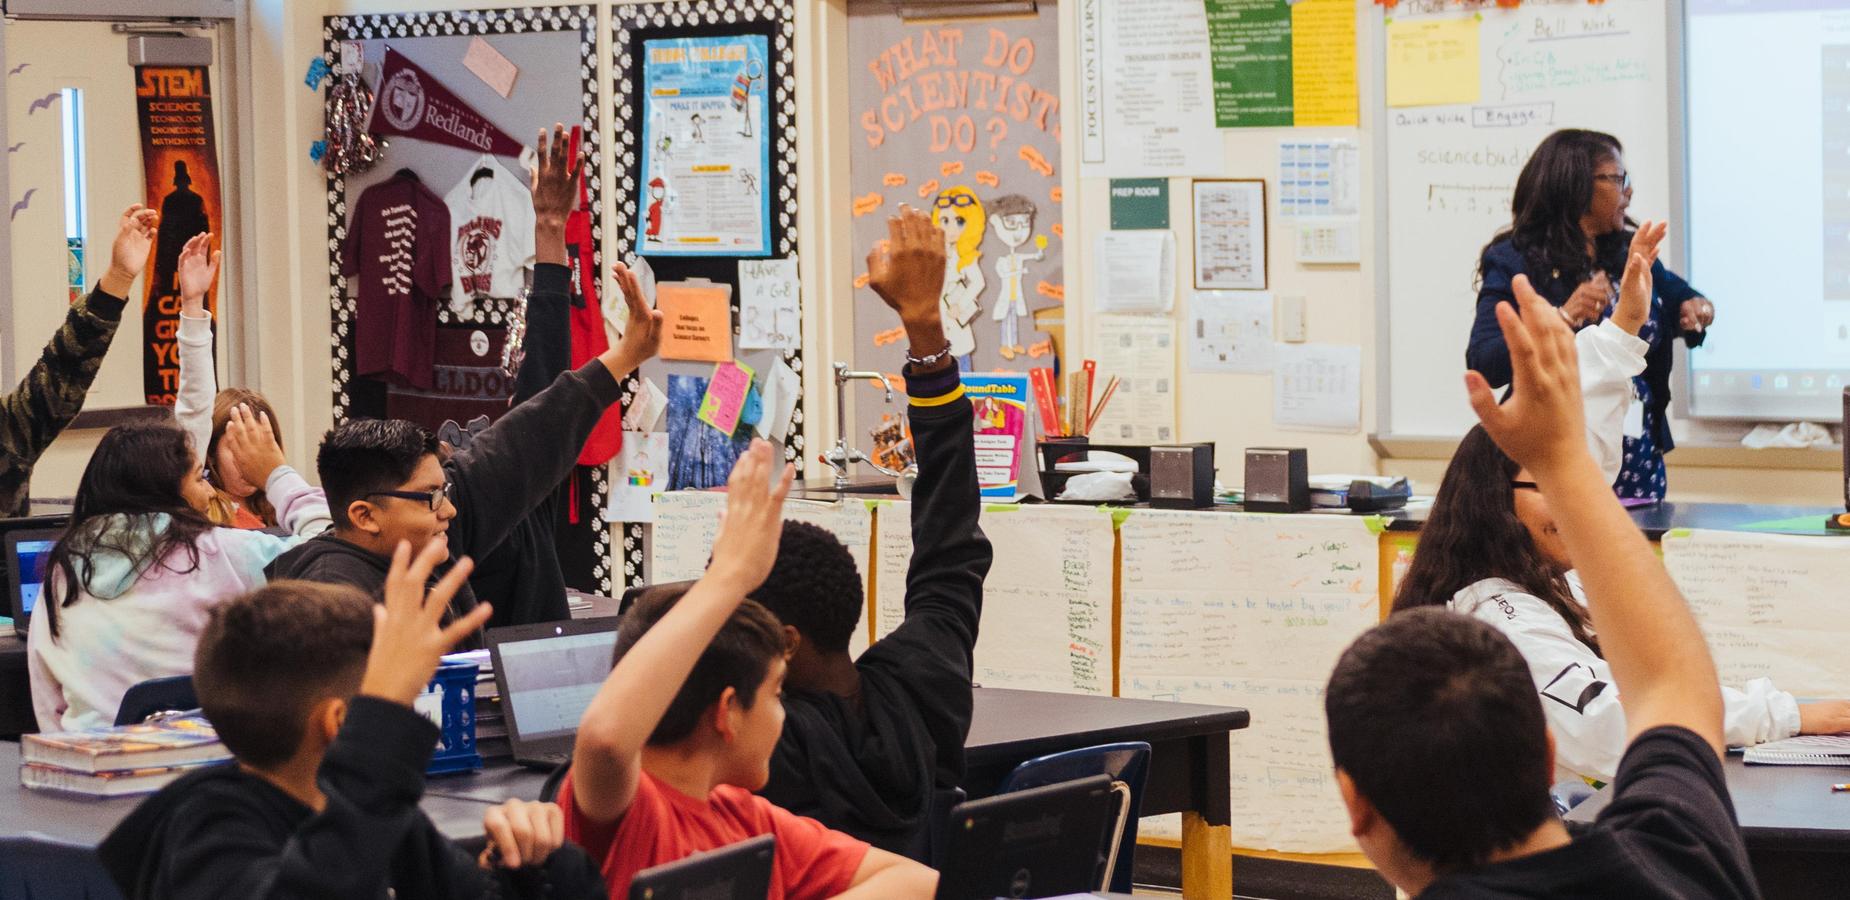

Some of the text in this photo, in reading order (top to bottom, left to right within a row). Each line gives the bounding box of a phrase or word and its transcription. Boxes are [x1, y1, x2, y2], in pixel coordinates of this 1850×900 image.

[867, 28, 1035, 93] WHAT DO
[1086, 58, 1096, 81] ON
[136, 68, 205, 97] STEM
[149, 102, 202, 112] SCIENCE
[1087, 84, 1097, 137] FOCUS
[150, 115, 203, 123] TECHNOLOGY
[1396, 113, 1466, 126] Quick Write
[1485, 110, 1536, 127] Engage
[152, 126, 205, 135] ENGINEERING
[426, 104, 493, 150] Redlands
[152, 137, 207, 146] MATHEMATICS
[1112, 186, 1160, 198] PREP ROOM
[744, 263, 781, 279] HAVE
[756, 284, 764, 297] A
[158, 295, 183, 316] CA
[152, 343, 181, 366] YO
[963, 383, 1017, 394] oundTable
